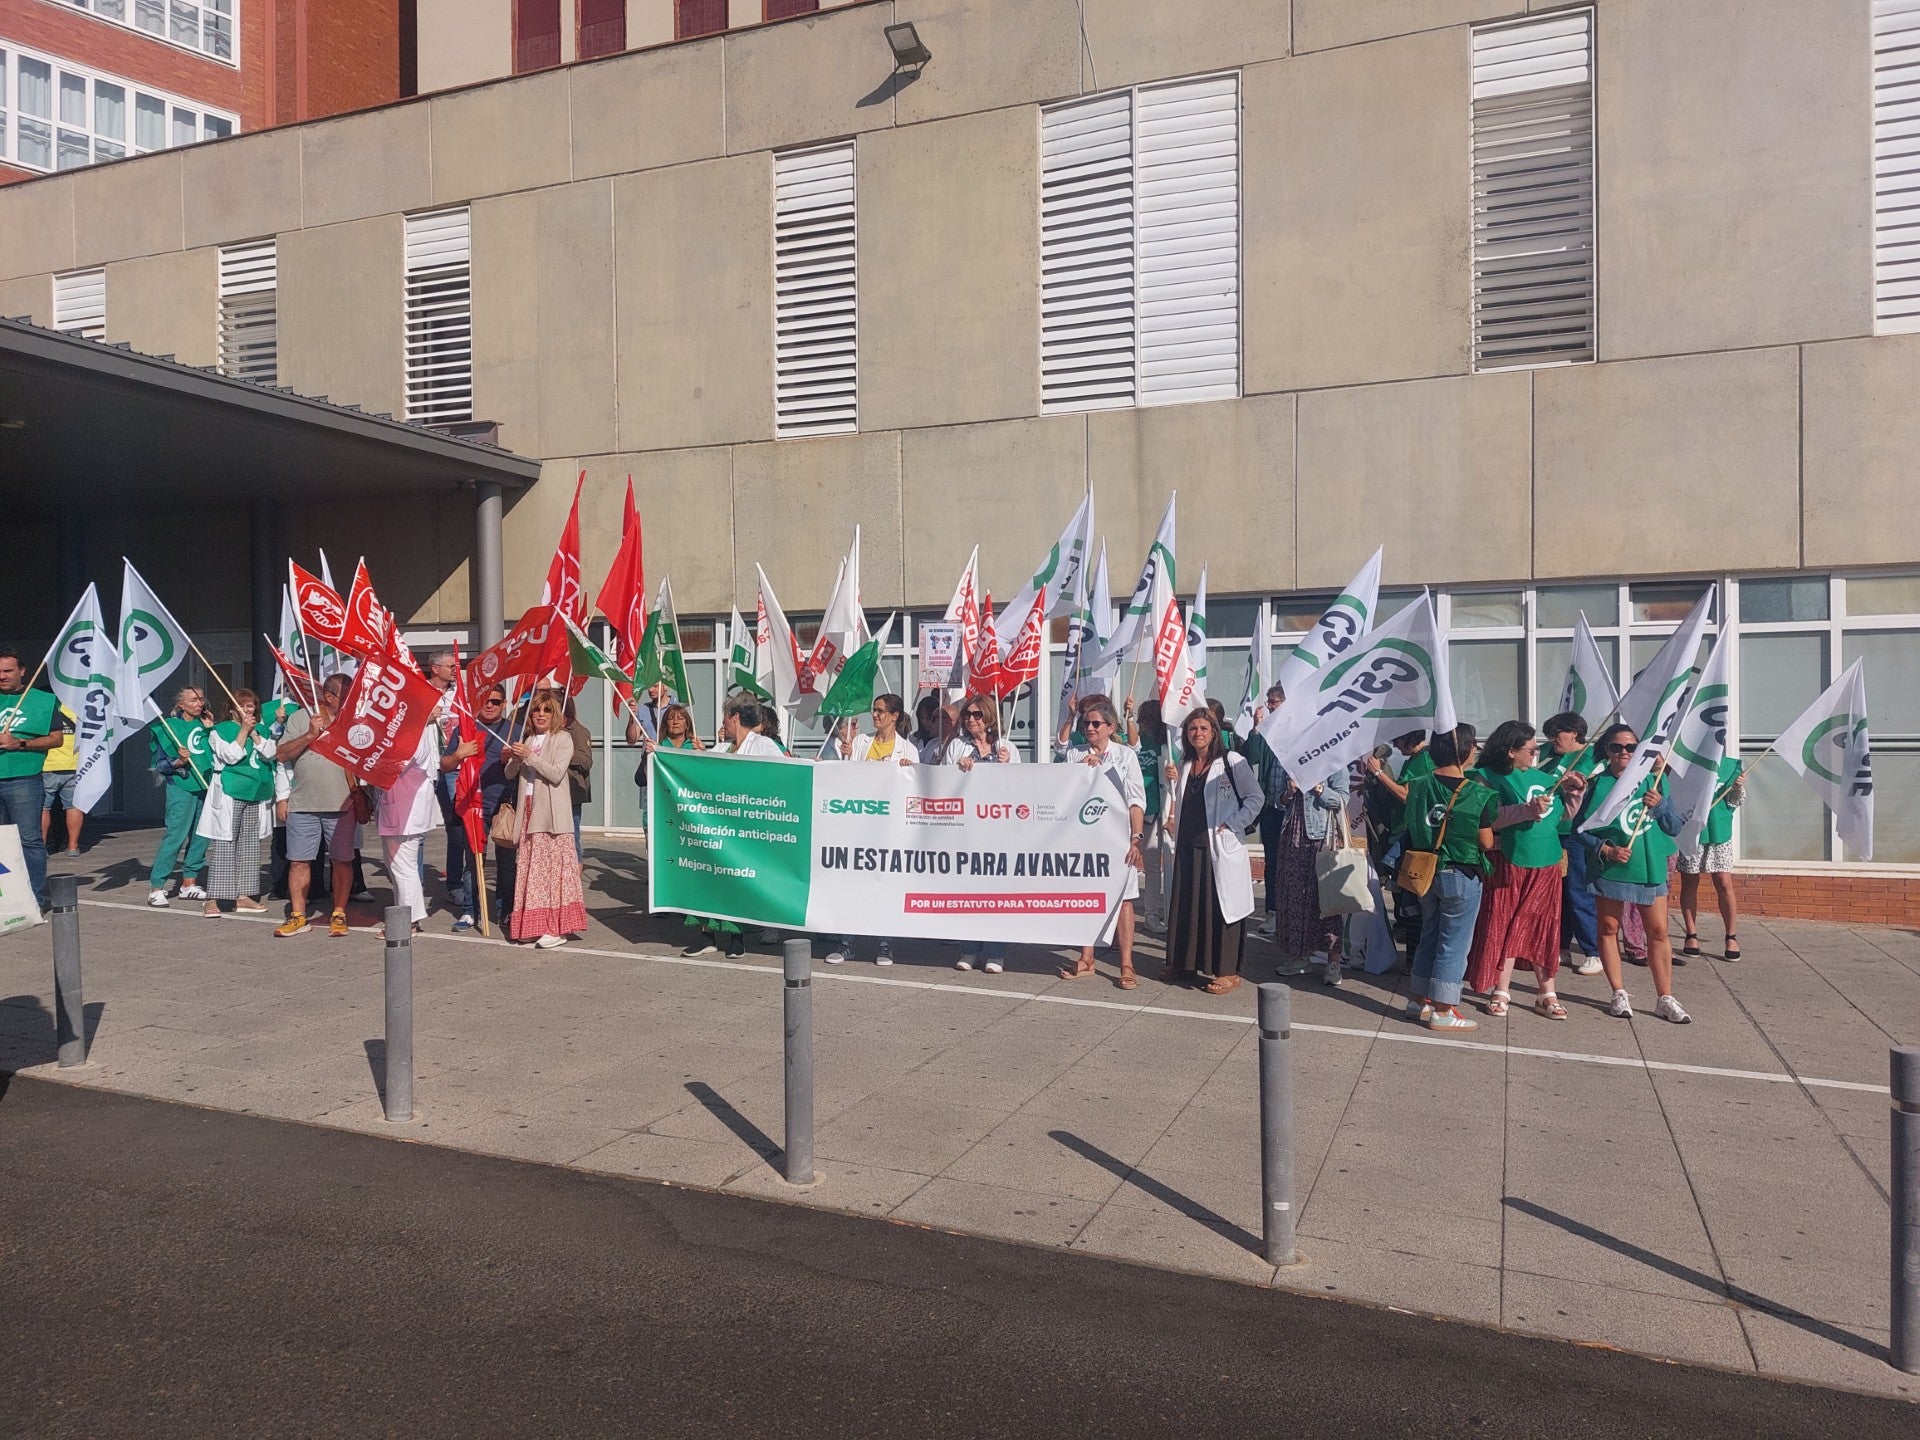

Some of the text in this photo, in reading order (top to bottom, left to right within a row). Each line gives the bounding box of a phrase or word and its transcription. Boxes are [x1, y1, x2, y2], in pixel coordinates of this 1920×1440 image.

[677, 787, 787, 808] Nueva clasificación
[924, 801, 962, 812] CCOO
[677, 802, 800, 823] profesional retribuida
[828, 799, 890, 815] SATSE
[976, 804, 1013, 819] UGT
[678, 821, 797, 844] Jubilación anticipada
[679, 836, 723, 850] y parcial
[678, 857, 756, 878] Mejora jornada
[821, 846, 1110, 877] UN ESTATUTO PARA AVANZAR
[910, 899, 1100, 909] POR UN ESTATUTO PARA TODAS/TODOS
